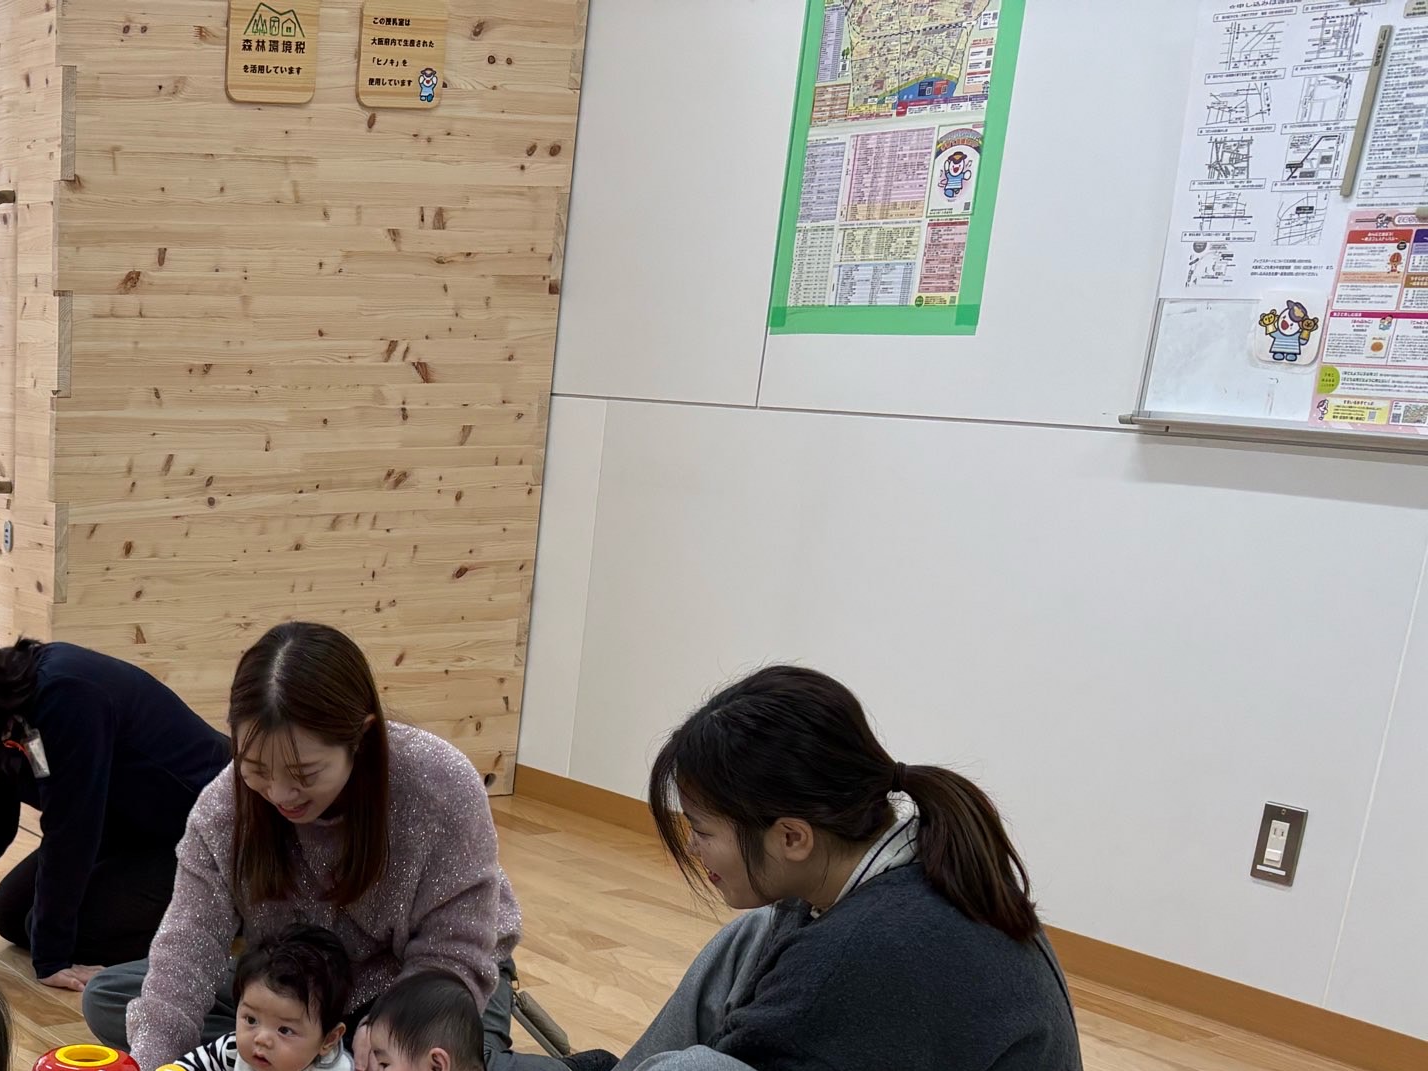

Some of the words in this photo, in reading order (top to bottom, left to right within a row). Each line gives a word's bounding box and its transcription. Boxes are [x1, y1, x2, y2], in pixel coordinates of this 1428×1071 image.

[372, 17, 411, 26] この授乳室は
[242, 39, 305, 53] 森林環境税
[371, 37, 435, 48] 大阪府内で生産された
[243, 64, 302, 75] を活用しています
[368, 77, 413, 87] 使用しています
